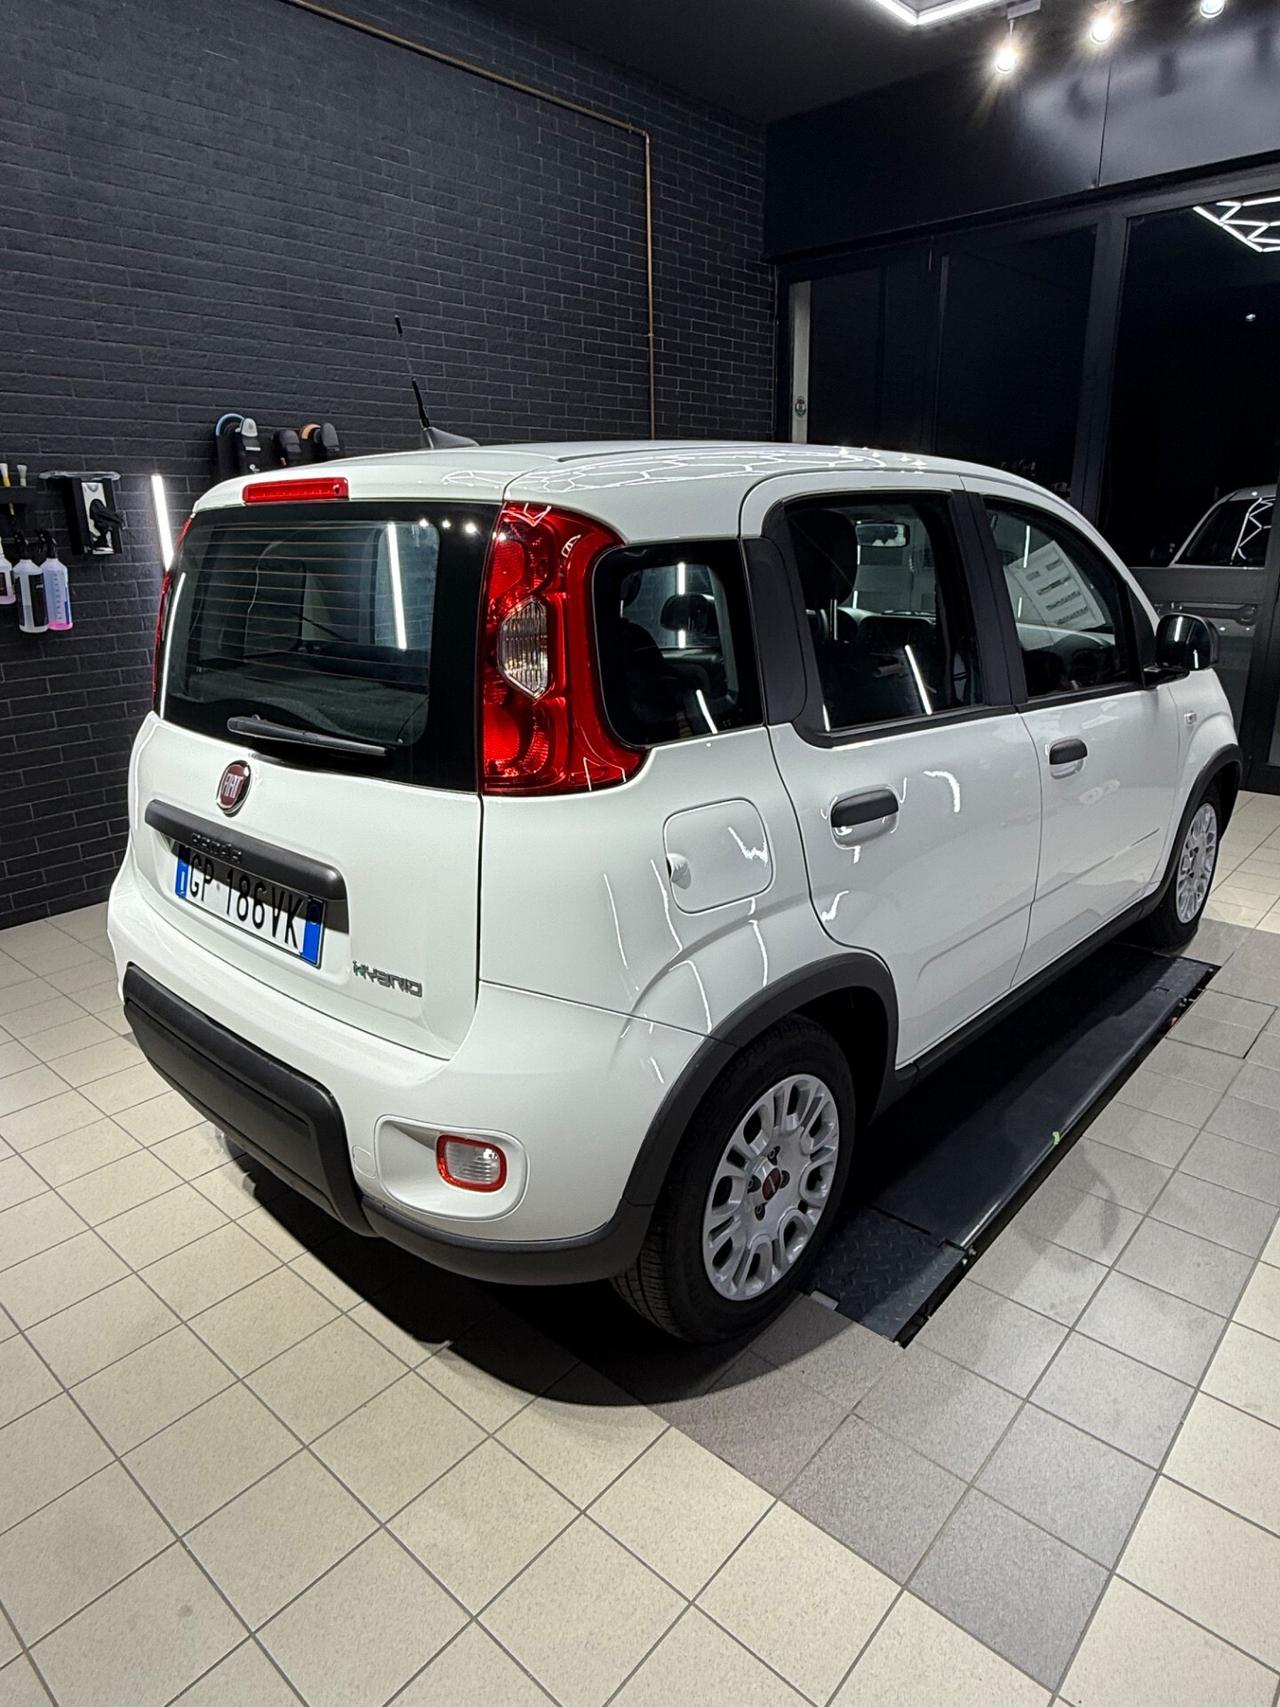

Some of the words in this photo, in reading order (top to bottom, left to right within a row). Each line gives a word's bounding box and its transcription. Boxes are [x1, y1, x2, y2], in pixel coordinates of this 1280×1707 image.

[223, 772, 244, 799] FIAT
[189, 853, 215, 902] GP
[226, 868, 306, 950] 186VK
